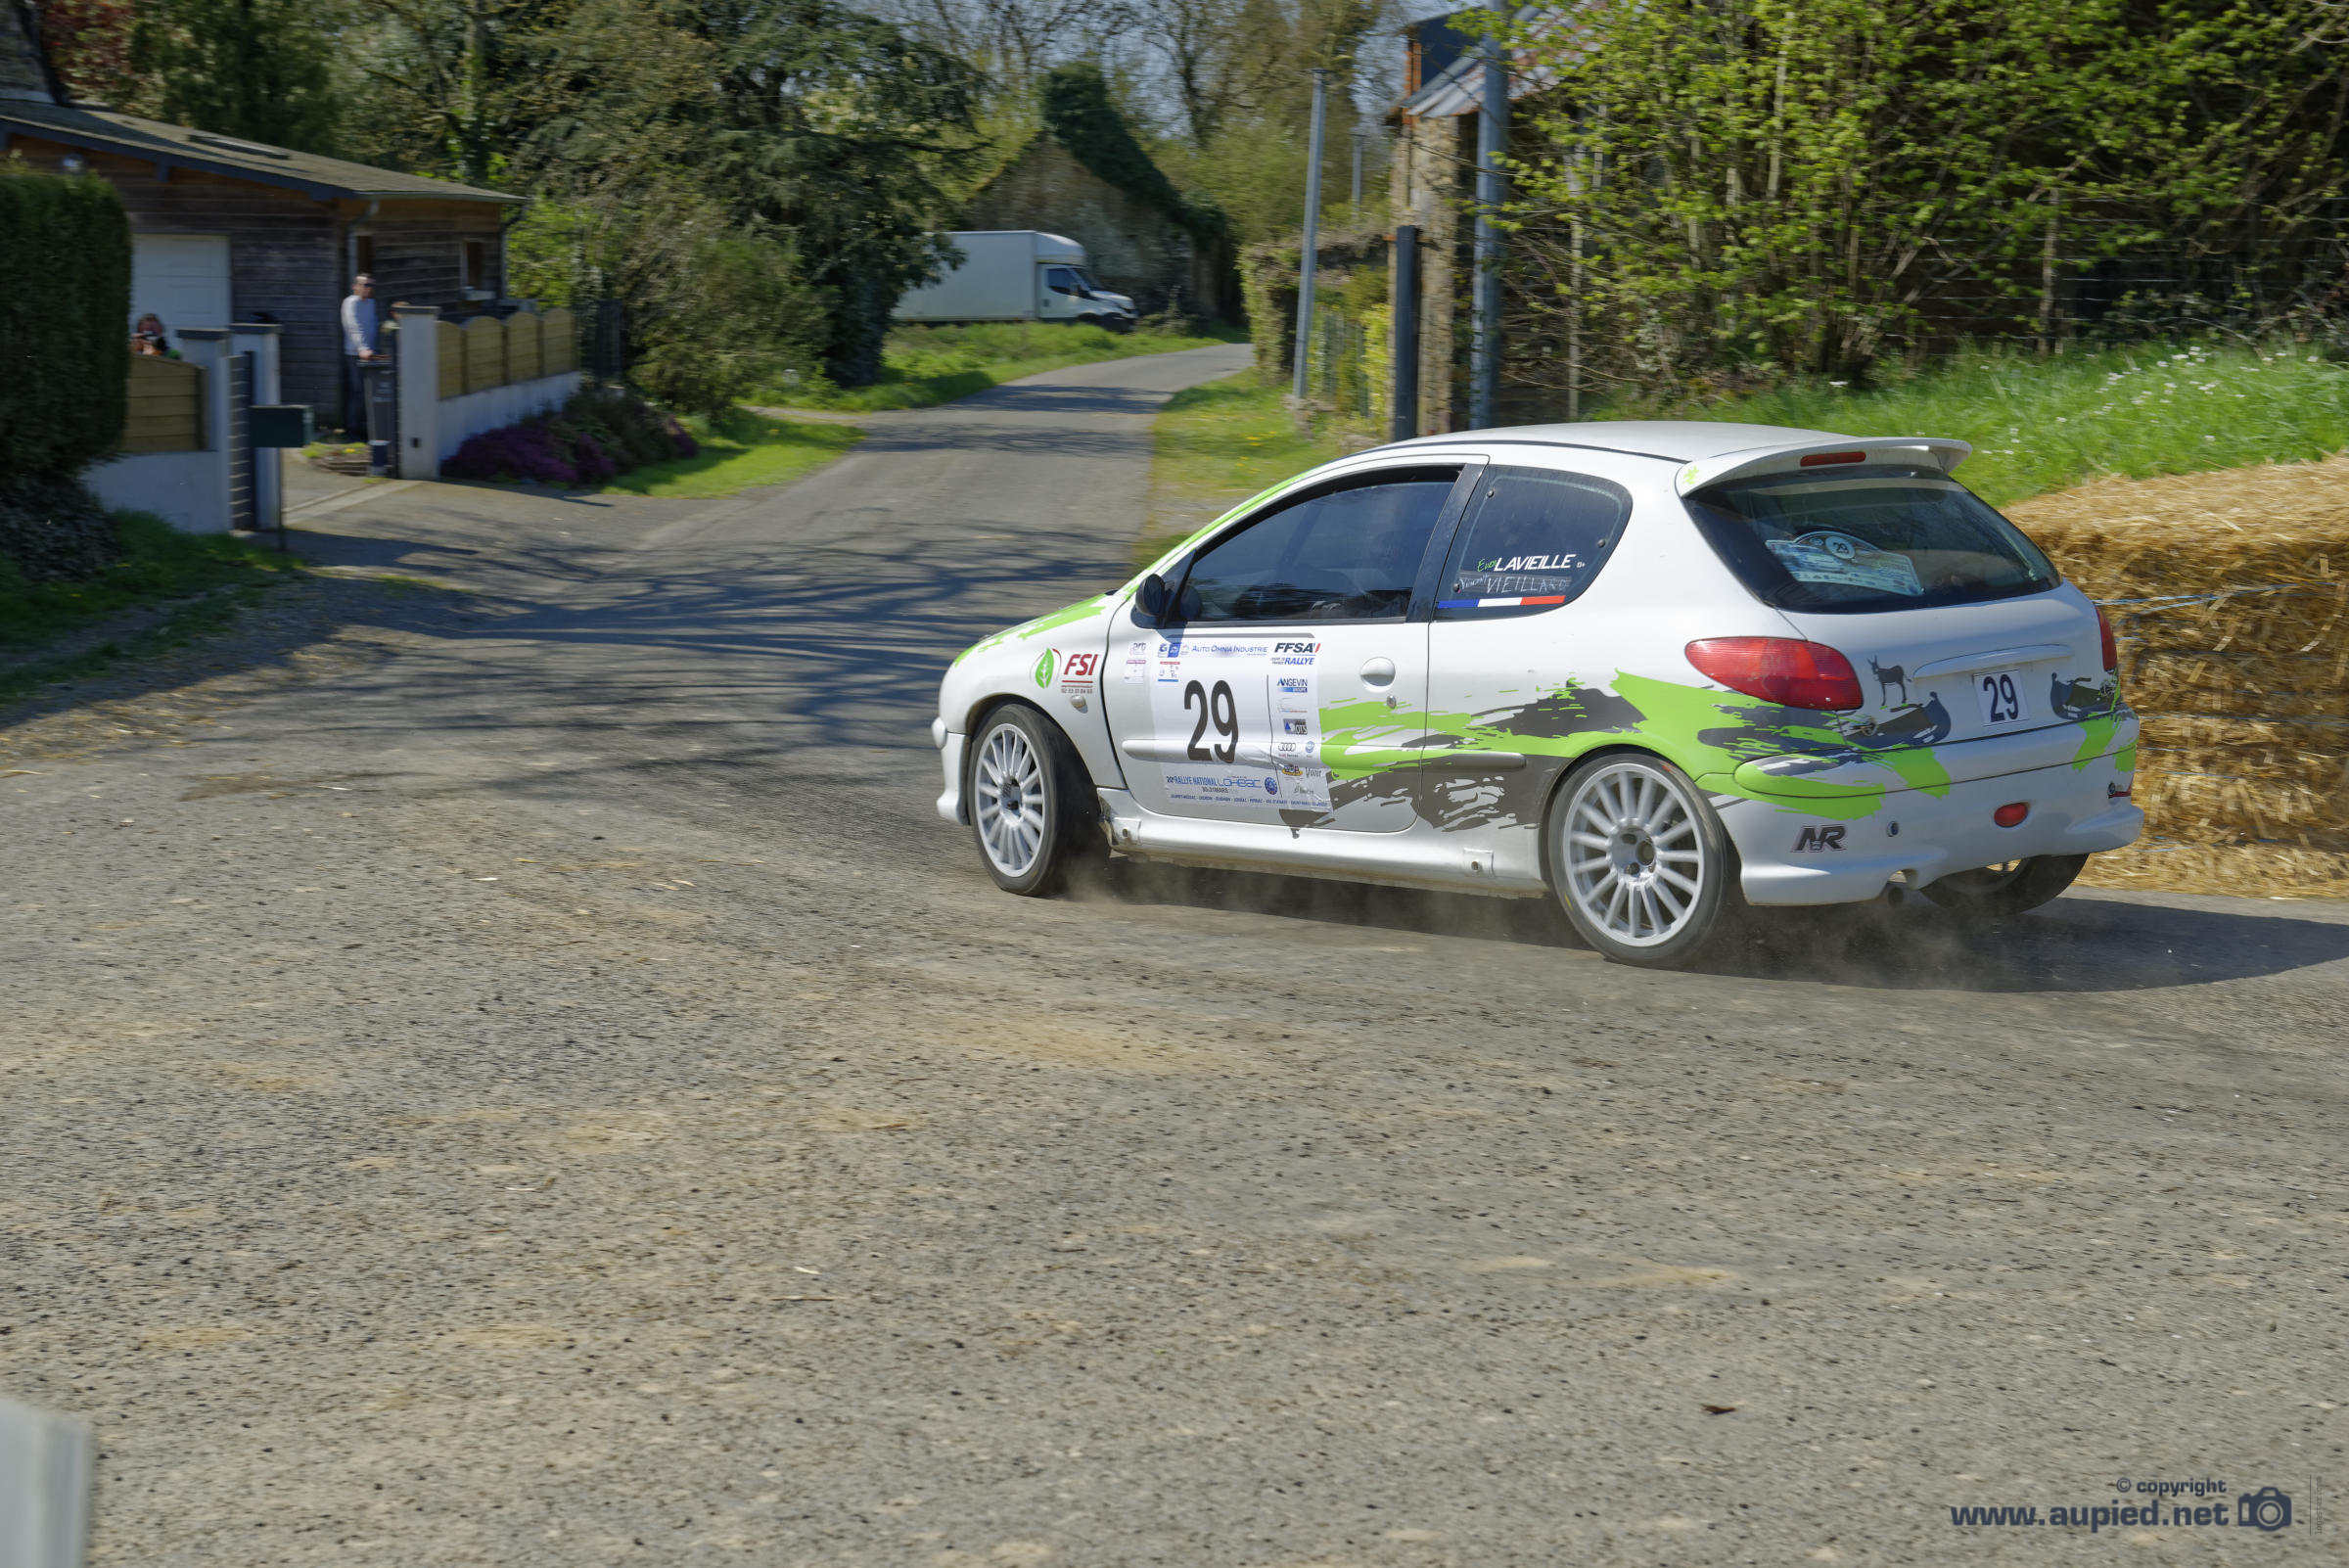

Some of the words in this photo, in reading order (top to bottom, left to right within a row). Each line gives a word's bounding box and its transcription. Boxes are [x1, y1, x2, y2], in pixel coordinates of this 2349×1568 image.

[1833, 541, 1850, 554] 29
[1494, 554, 1577, 572] LAVIEILLE
[1274, 642, 1313, 654] FFSA
[1064, 654, 1098, 675] FSI
[1284, 657, 1315, 666] RALLYE
[1277, 676, 1308, 687] ANGEVIN
[1983, 673, 2018, 722] 29
[1183, 679, 1239, 763] 29
[1174, 776, 1192, 785] RALLYE
